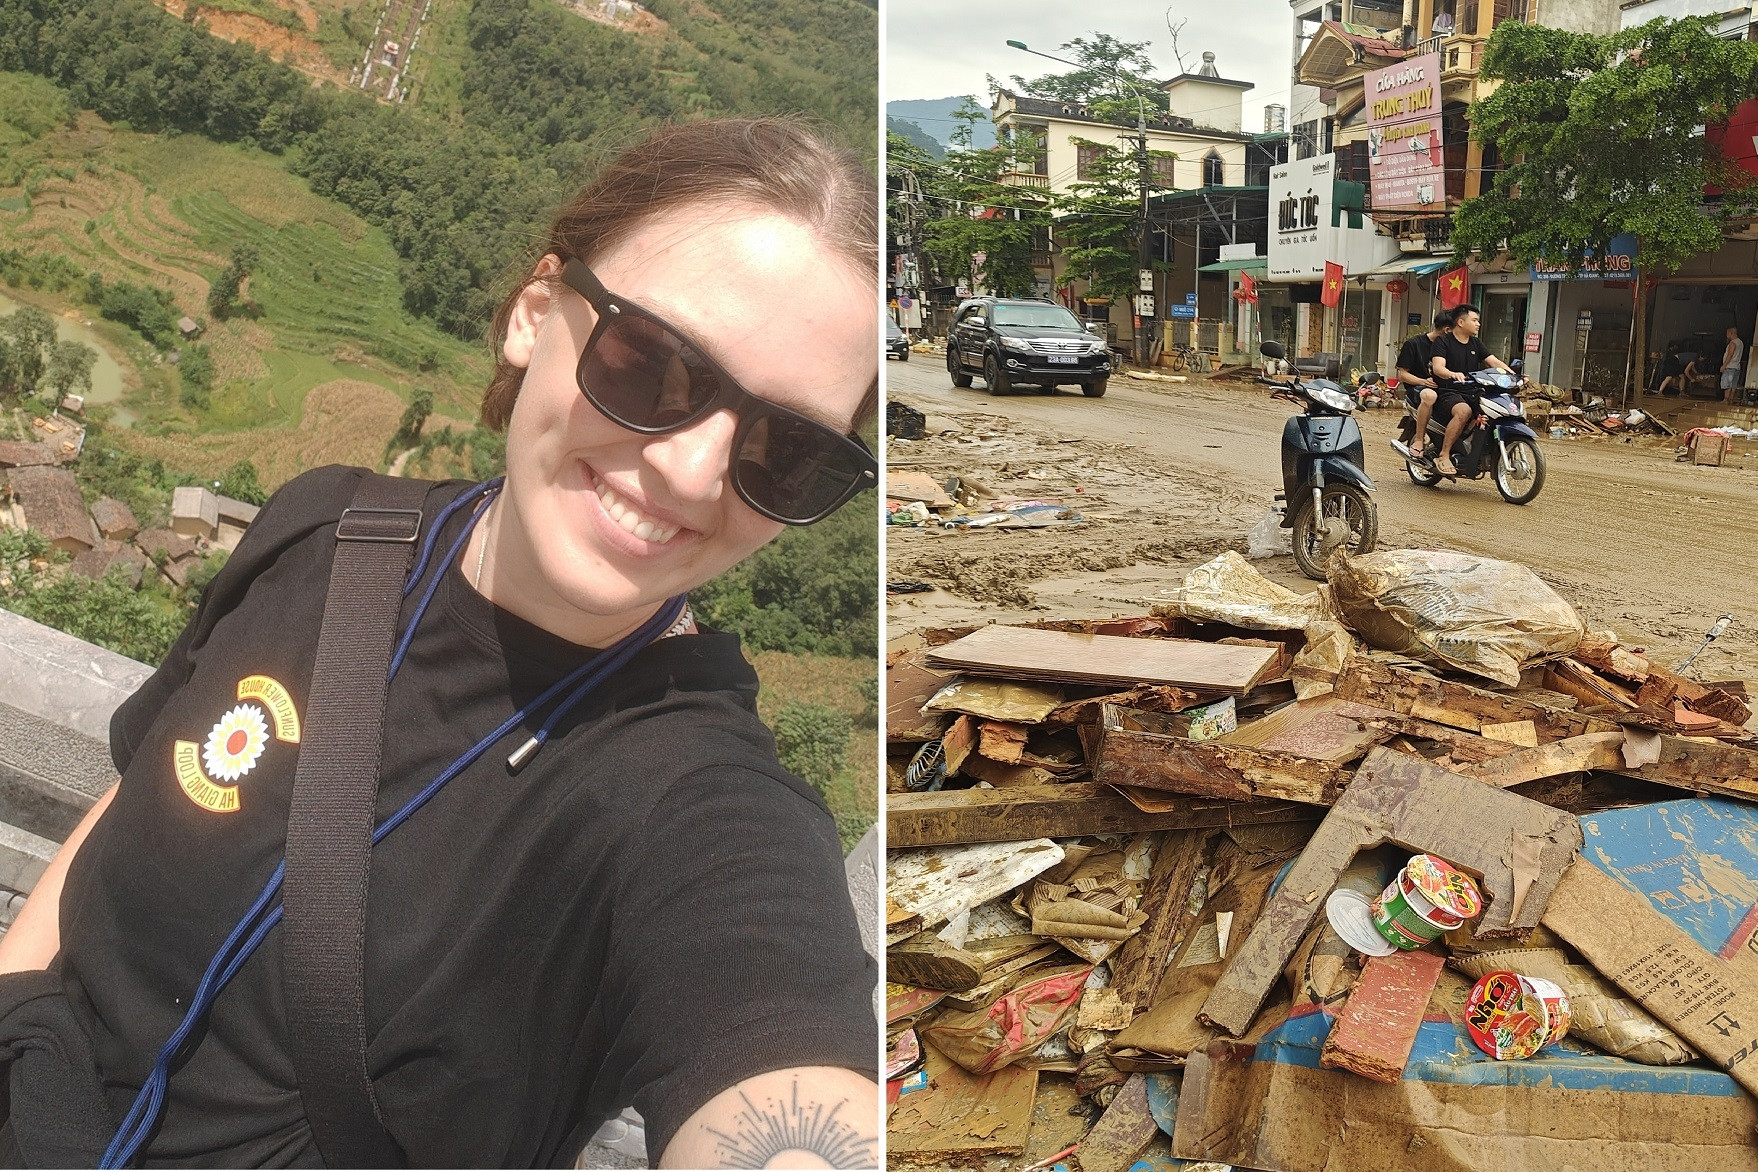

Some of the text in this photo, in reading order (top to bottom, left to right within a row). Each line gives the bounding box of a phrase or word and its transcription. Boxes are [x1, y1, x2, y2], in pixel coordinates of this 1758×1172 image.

[1371, 96, 1404, 120] TRUNG
[1300, 187, 1319, 228] TÓC
[1650, 860, 1663, 869] IN
[1672, 987, 1686, 999] SET
[1702, 977, 1718, 991] BIKE
[1674, 983, 1727, 1023] TOTEM CHILDREN
